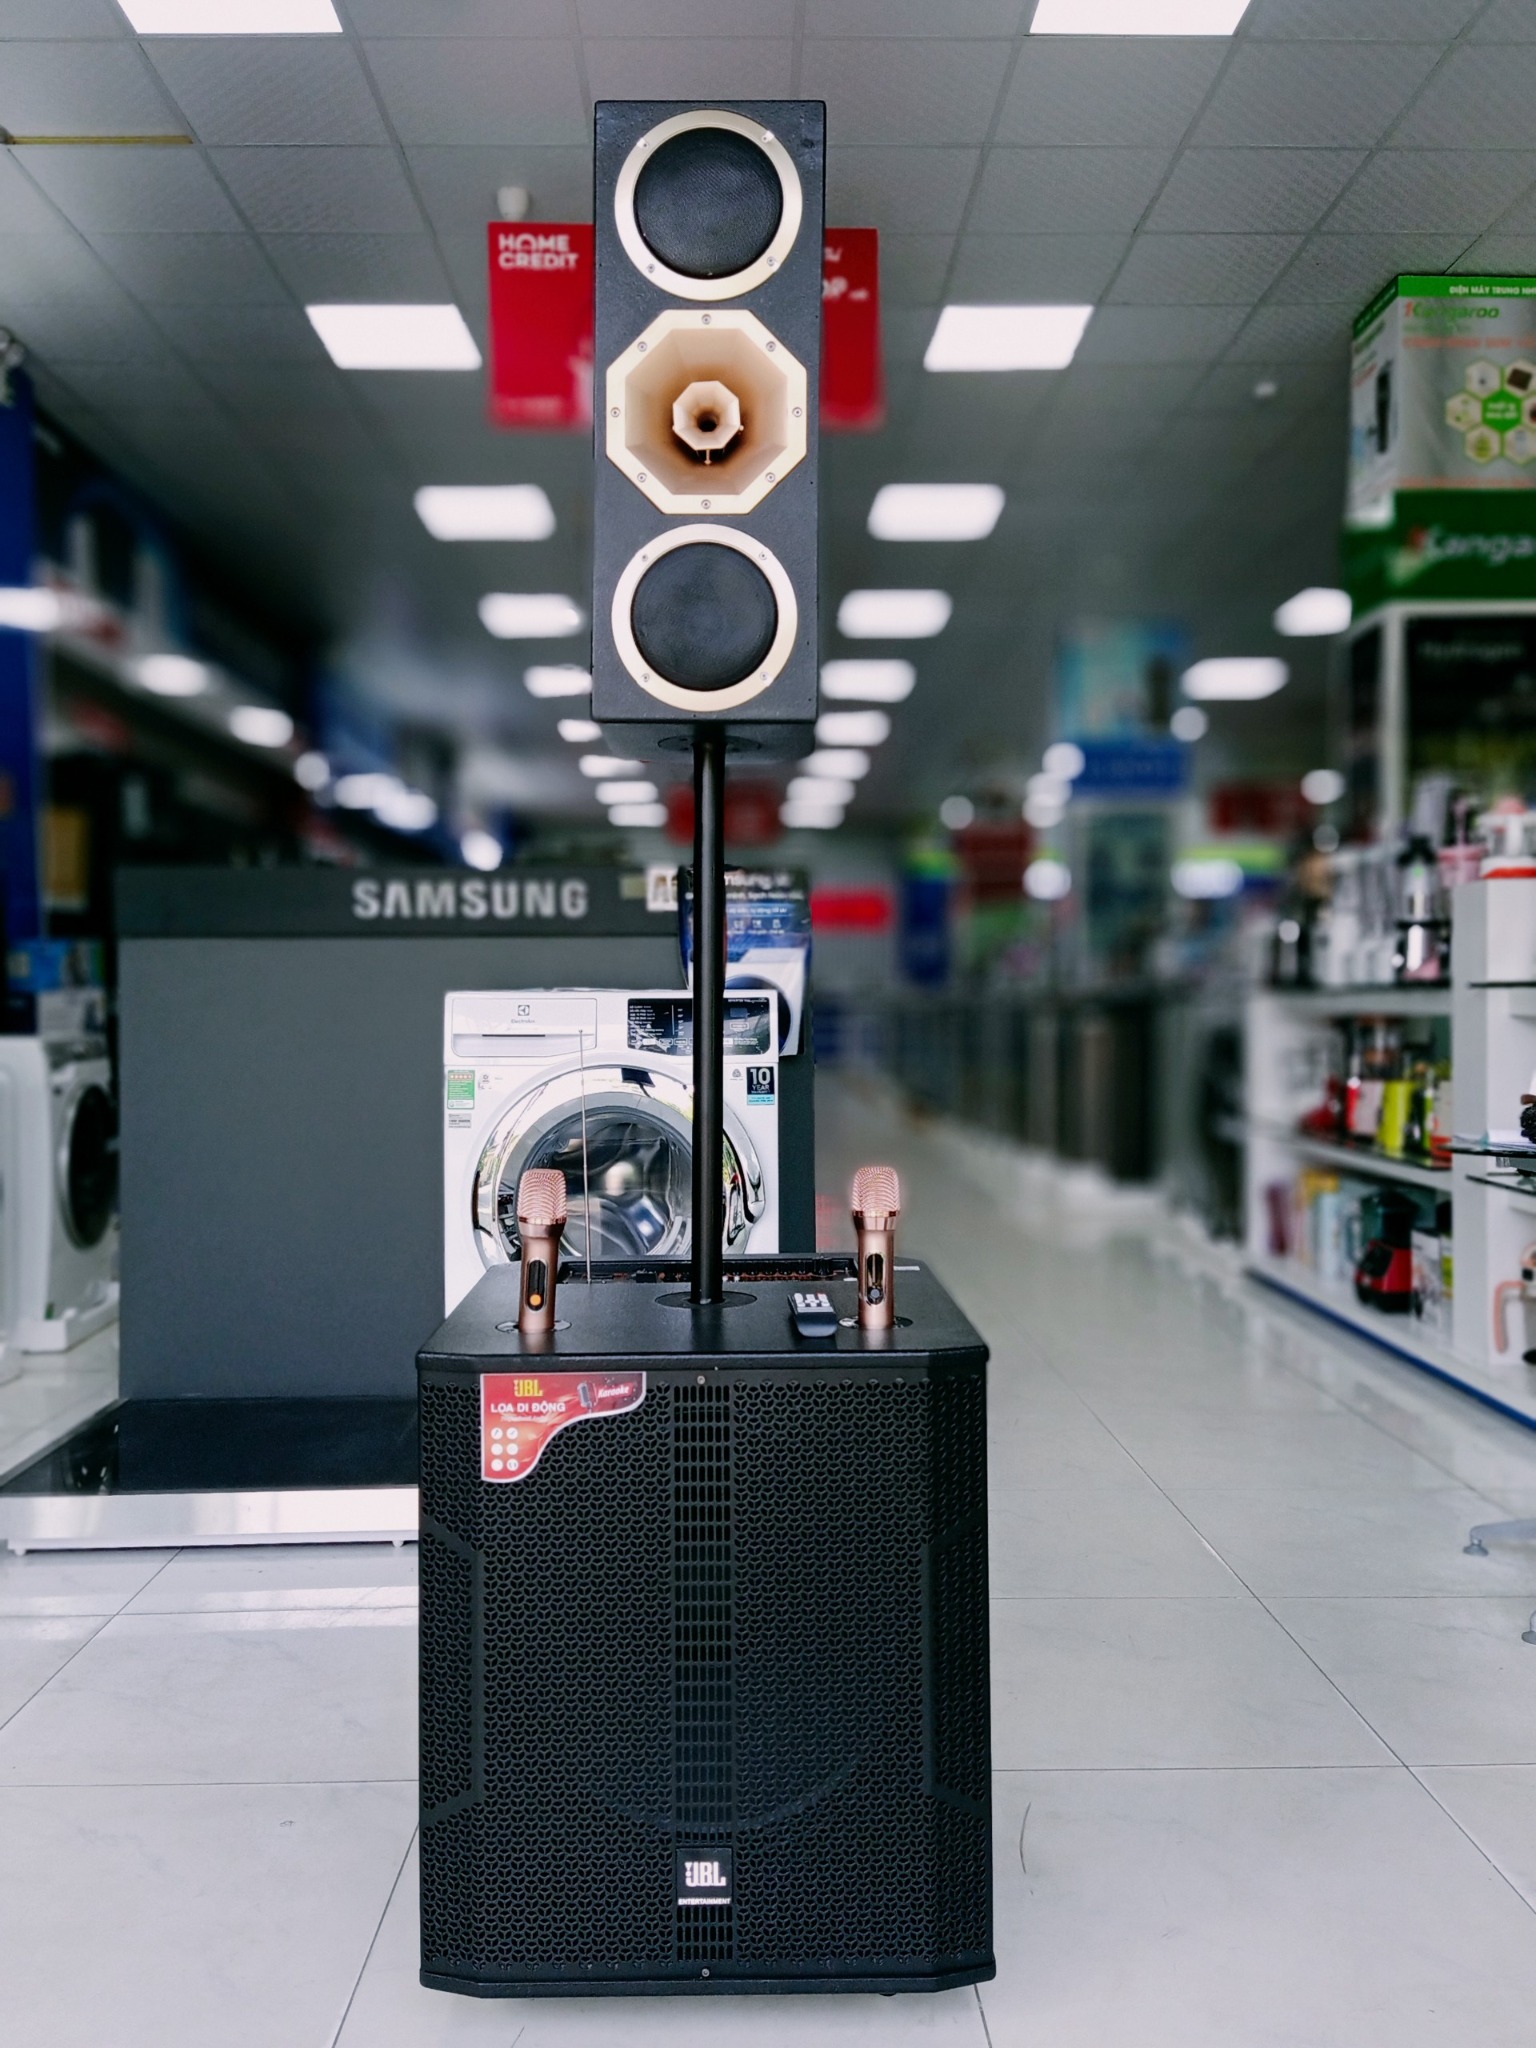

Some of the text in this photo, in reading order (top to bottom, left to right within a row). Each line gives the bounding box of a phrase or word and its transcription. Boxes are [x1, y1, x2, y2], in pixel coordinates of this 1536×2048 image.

[498, 233, 570, 251] HOME
[498, 251, 579, 270] CREDIT
[353, 879, 588, 919] SAMSUNG
[750, 1067, 771, 1085] 10
[513, 1379, 543, 1397] JBL
[490, 1400, 566, 1414] LOA DI ĐỘNG
[684, 1860, 727, 1887] JBL
